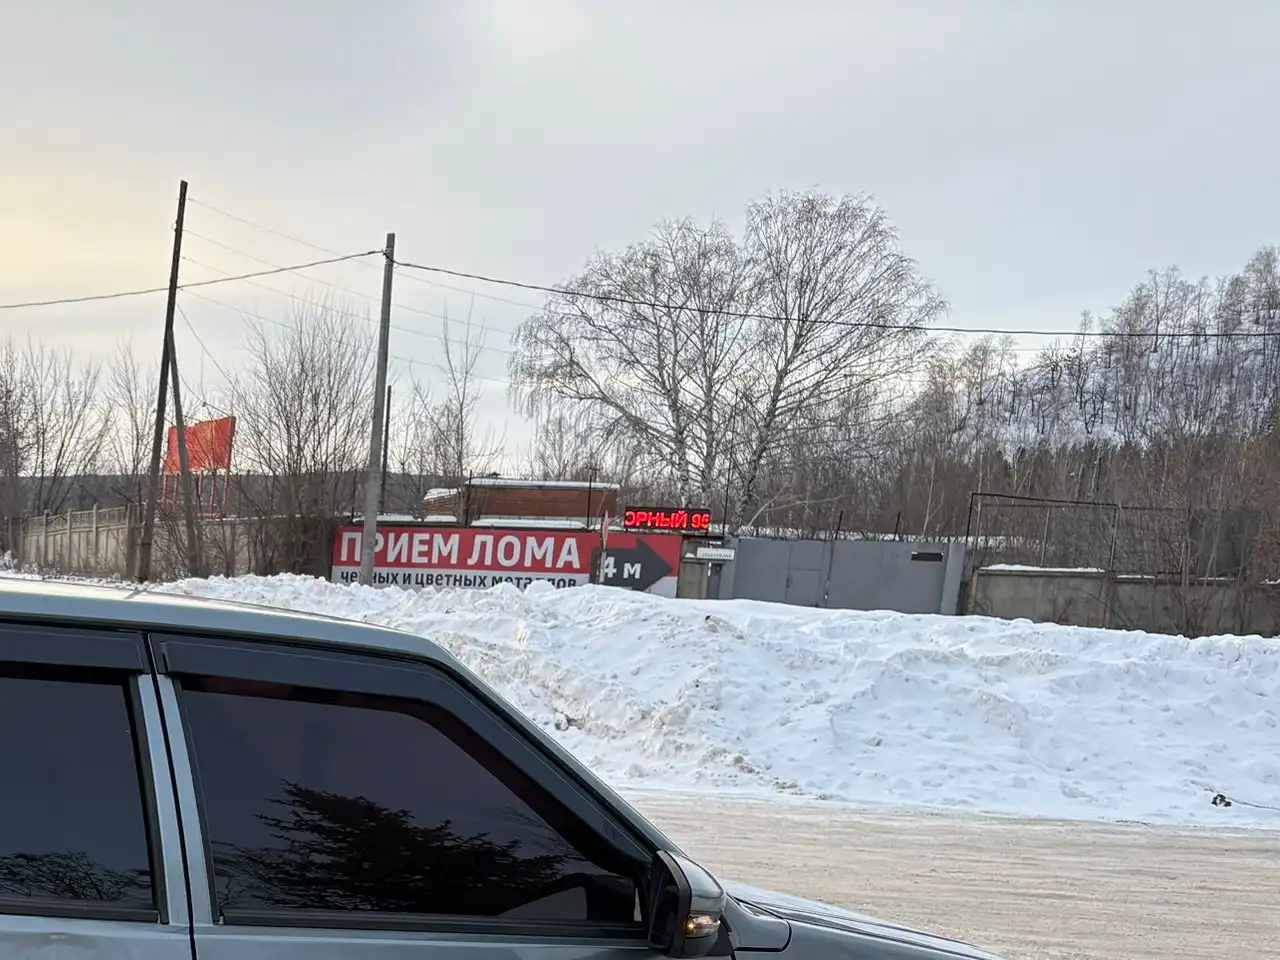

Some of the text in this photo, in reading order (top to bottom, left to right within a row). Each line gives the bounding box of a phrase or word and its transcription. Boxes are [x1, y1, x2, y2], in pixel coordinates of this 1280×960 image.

[466, 534, 581, 569] ЛОМА
[340, 571, 578, 590] чеых и цветных мтаов
